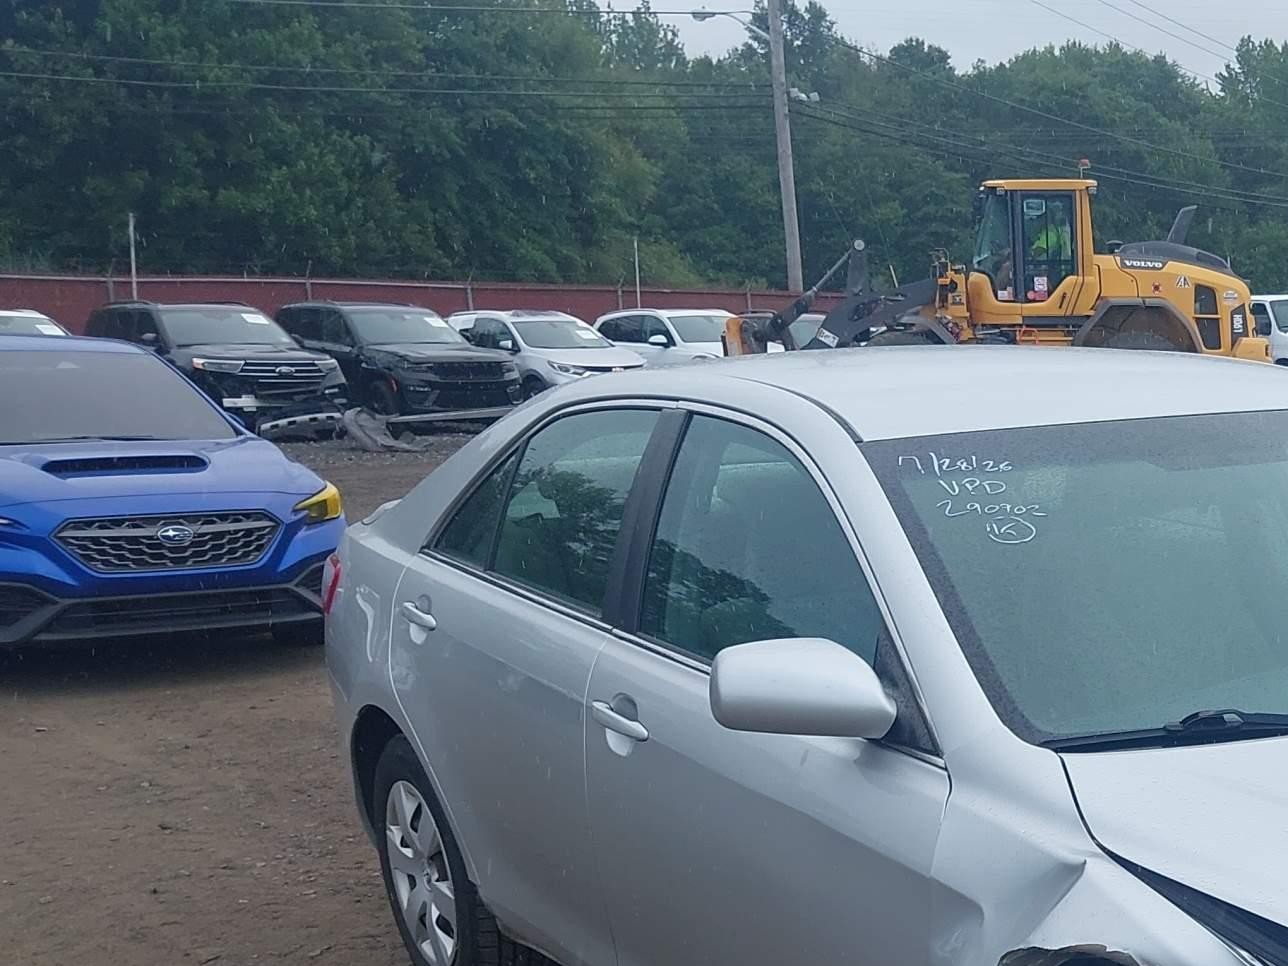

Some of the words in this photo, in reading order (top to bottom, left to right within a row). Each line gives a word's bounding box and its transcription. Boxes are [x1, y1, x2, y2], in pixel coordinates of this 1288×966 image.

[1124, 260, 1163, 268] VOLVO
[938, 477, 1007, 496] VPD
[936, 499, 1049, 517] 290702
